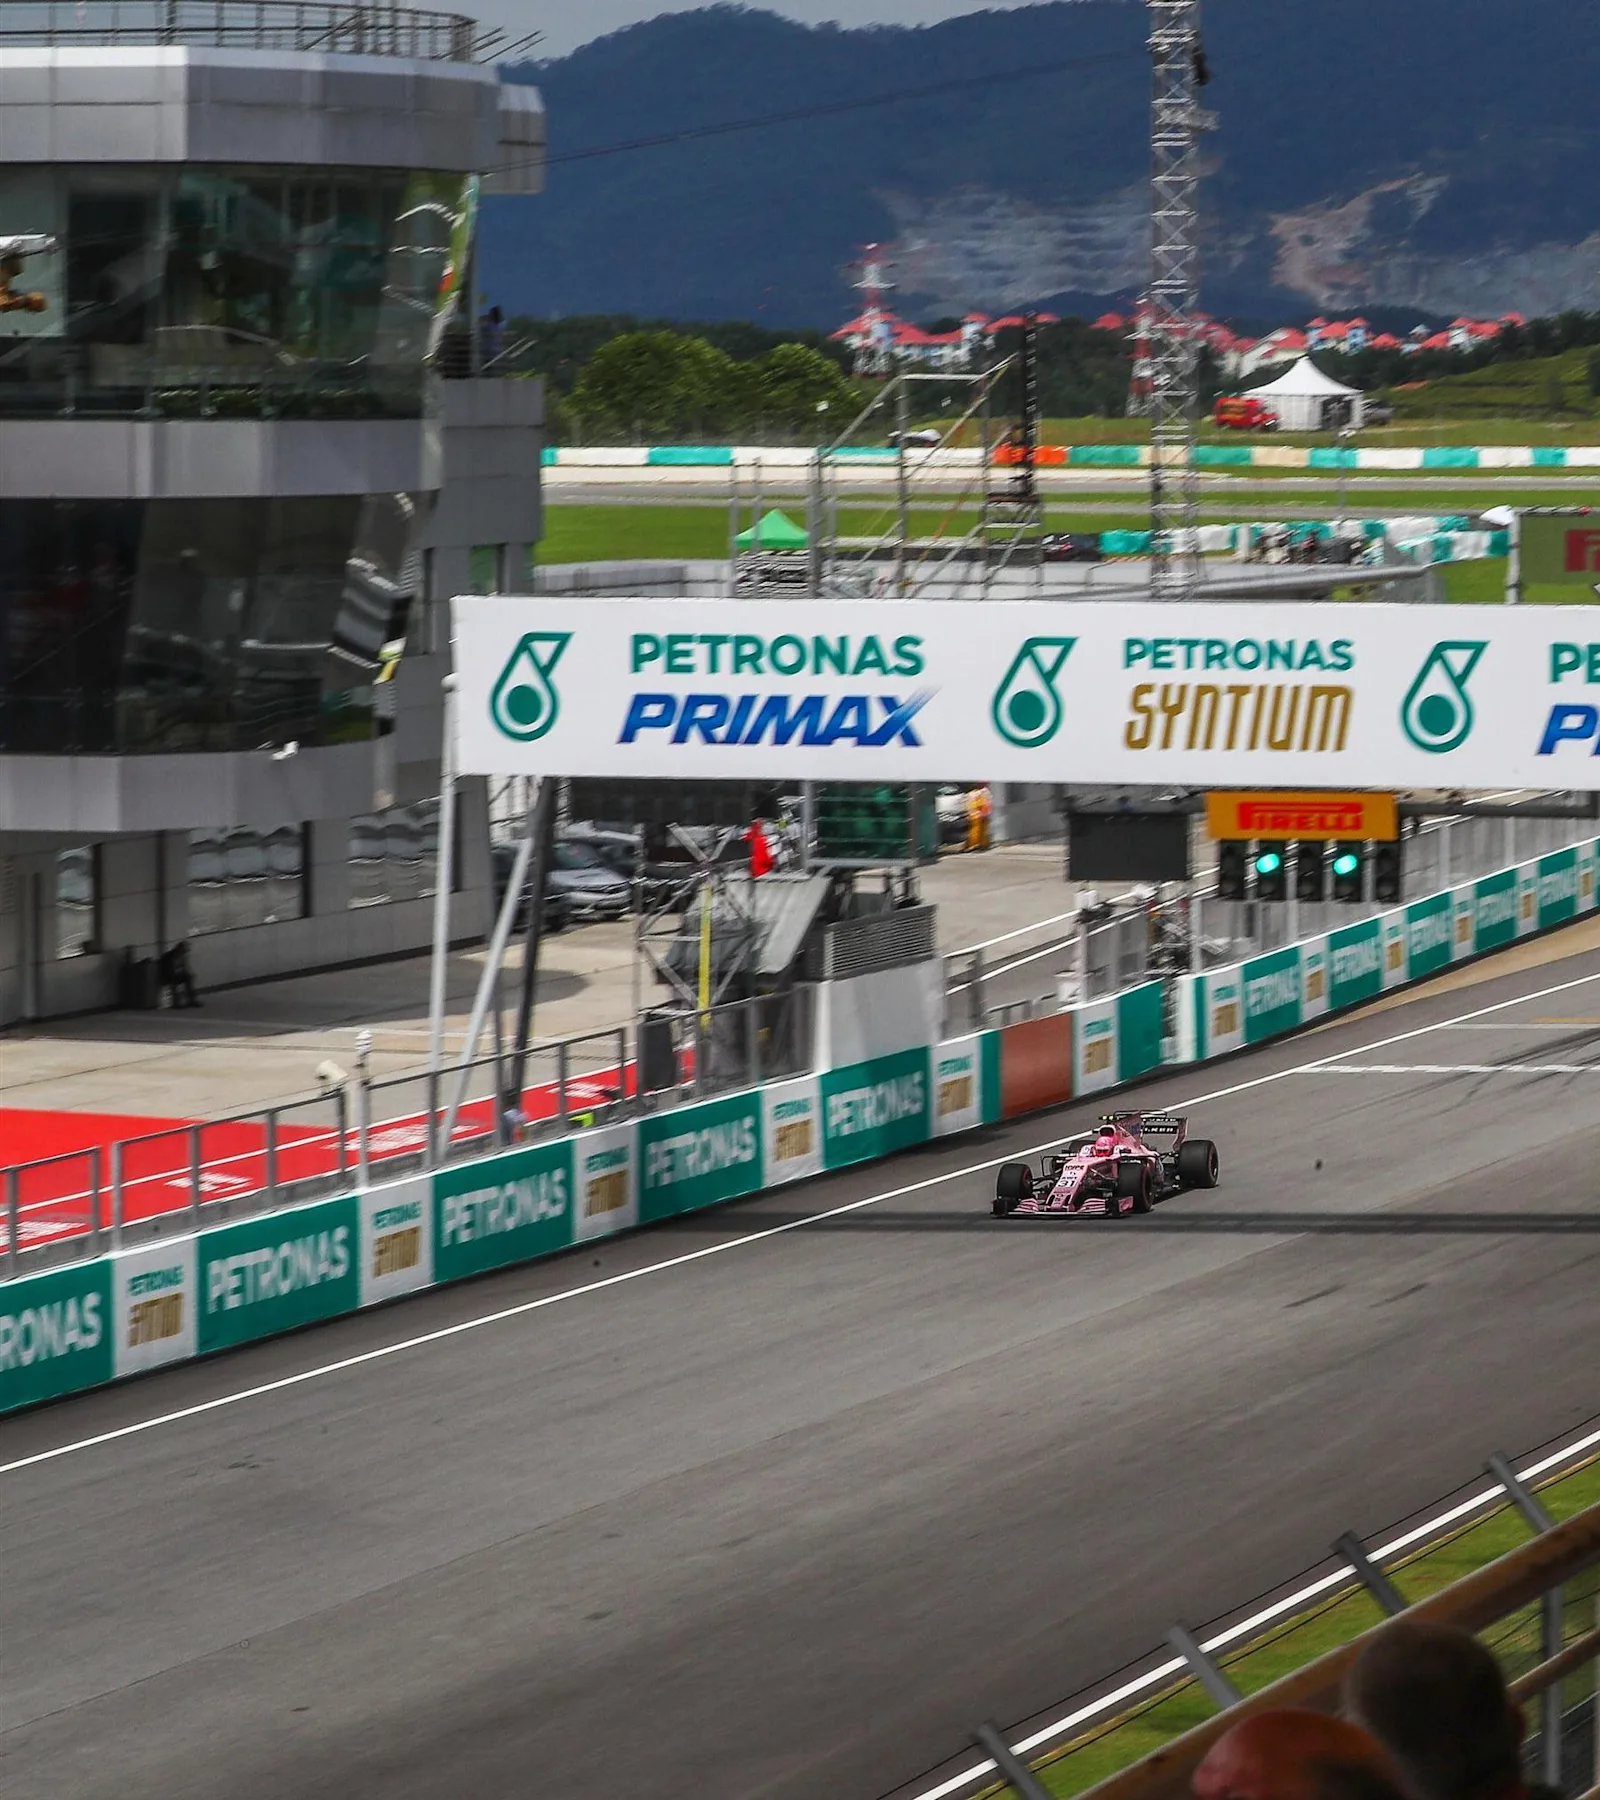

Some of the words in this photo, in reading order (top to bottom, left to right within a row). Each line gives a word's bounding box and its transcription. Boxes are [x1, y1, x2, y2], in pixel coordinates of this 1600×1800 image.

[631, 633, 924, 675] PETRONAS
[1123, 637, 1356, 671] PETRONAS
[616, 688, 940, 748] PRIMAX
[1124, 683, 1355, 753] SYNTIUM
[1236, 802, 1364, 831] PIRELLI
[827, 1070, 924, 1139] PETRONAS
[646, 1115, 757, 1189] PETRONAS
[442, 1167, 567, 1247] PETRONAS
[207, 1225, 349, 1315] PETRONAS
